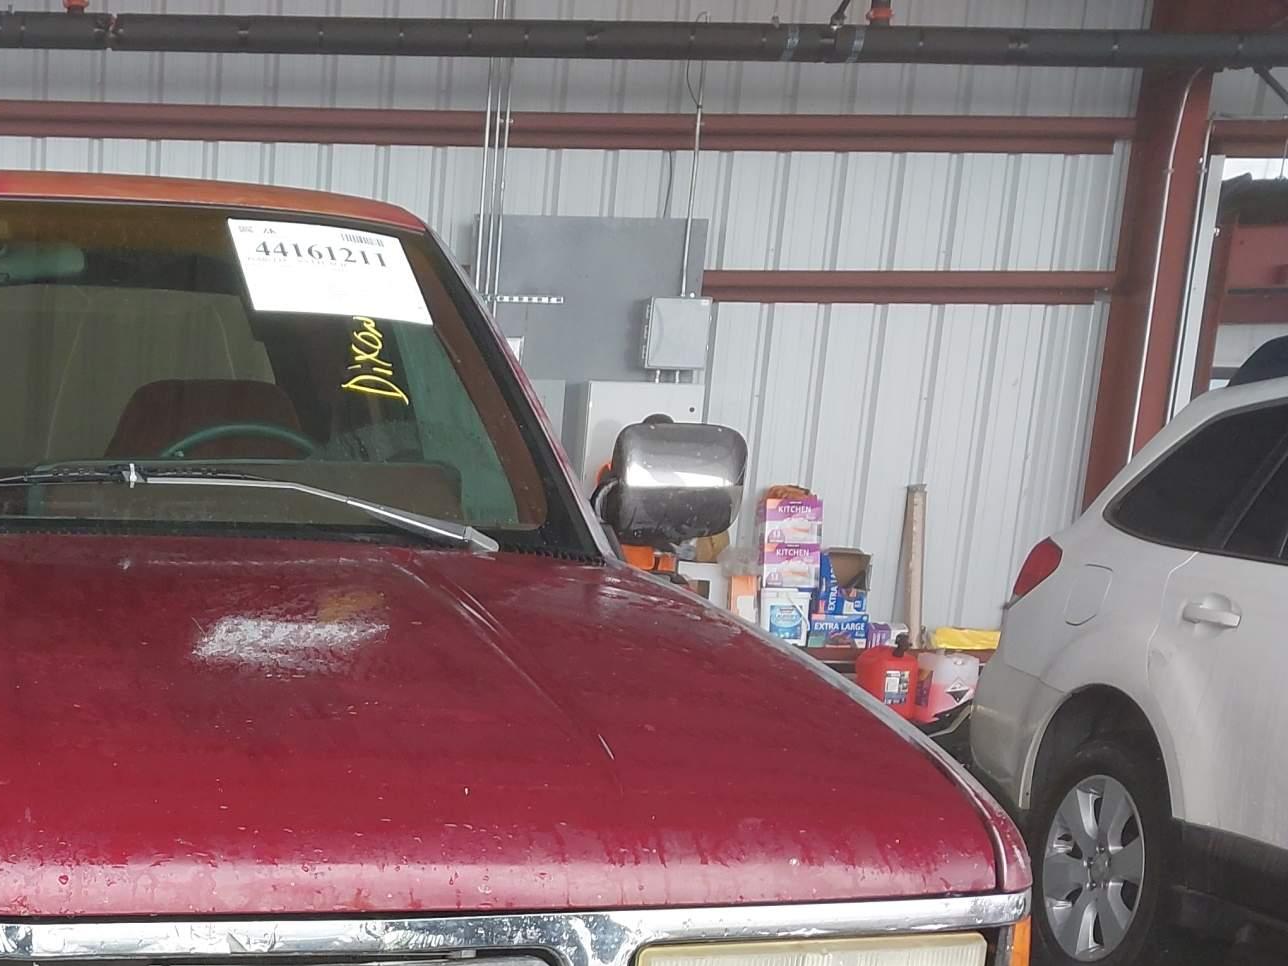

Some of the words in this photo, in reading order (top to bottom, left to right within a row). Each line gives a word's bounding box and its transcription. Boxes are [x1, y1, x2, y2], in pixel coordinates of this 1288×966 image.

[255, 240, 388, 268] 44161211
[778, 505, 812, 514] KITCHEN
[776, 548, 810, 557] KITCHEN
[827, 585, 838, 611] EXTRA
[814, 622, 839, 631] EXTRA
[841, 622, 865, 631] LARGE
